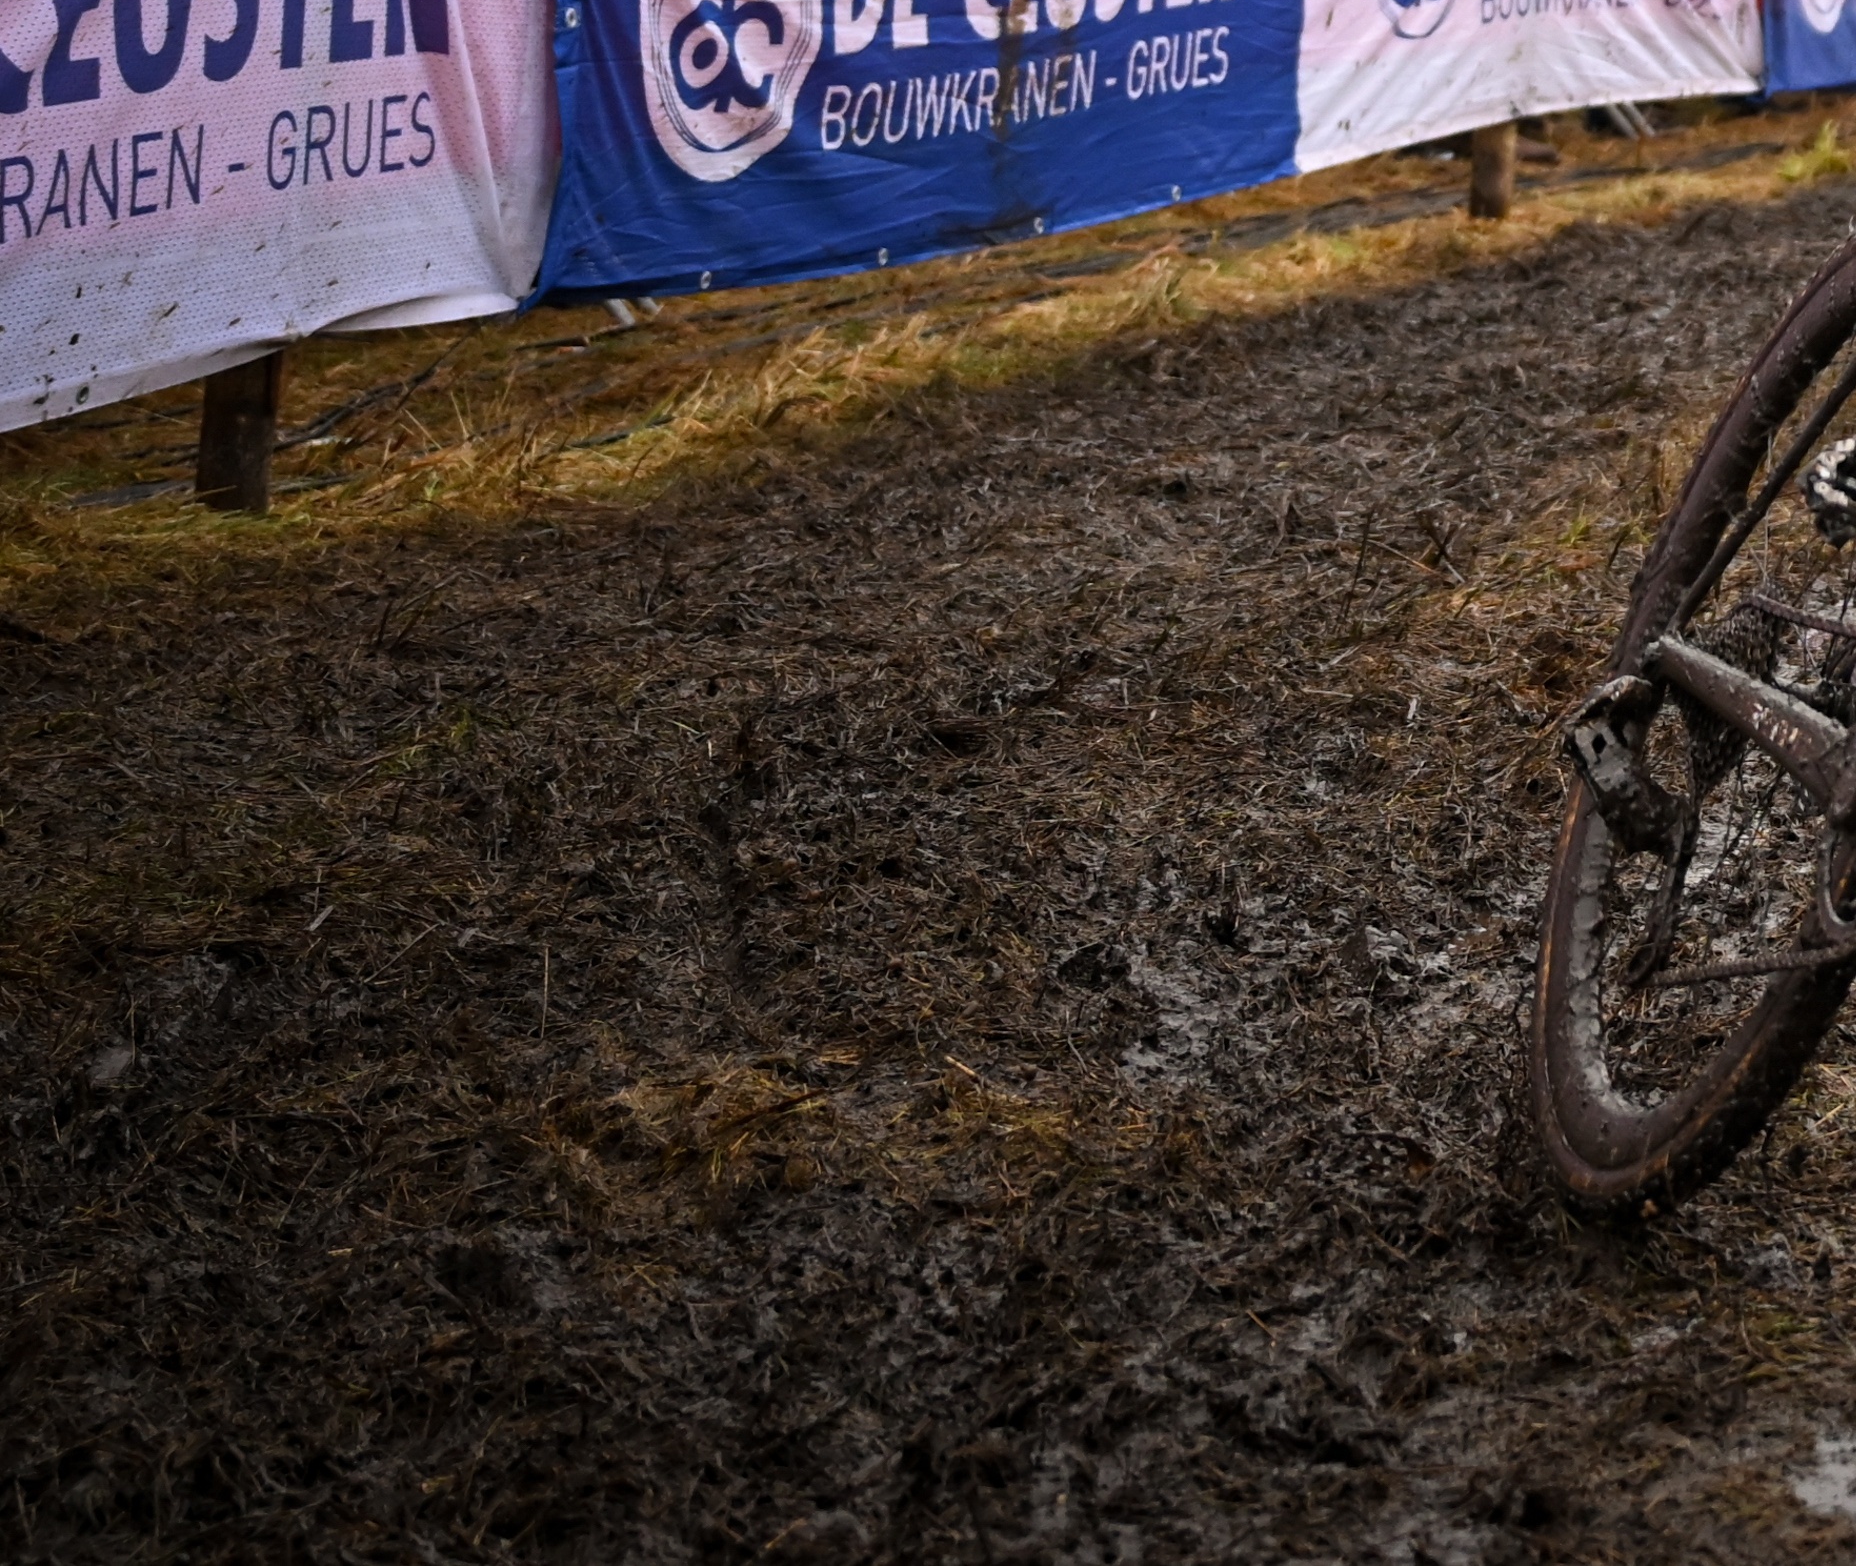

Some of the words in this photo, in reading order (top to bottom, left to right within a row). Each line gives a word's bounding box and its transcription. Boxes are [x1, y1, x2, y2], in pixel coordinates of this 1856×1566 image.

[821, 53, 1096, 151] BOUWKRANEN
[1126, 27, 1230, 100] GRUES
[0, 124, 204, 244] RANEN
[267, 91, 437, 191] GRUES
